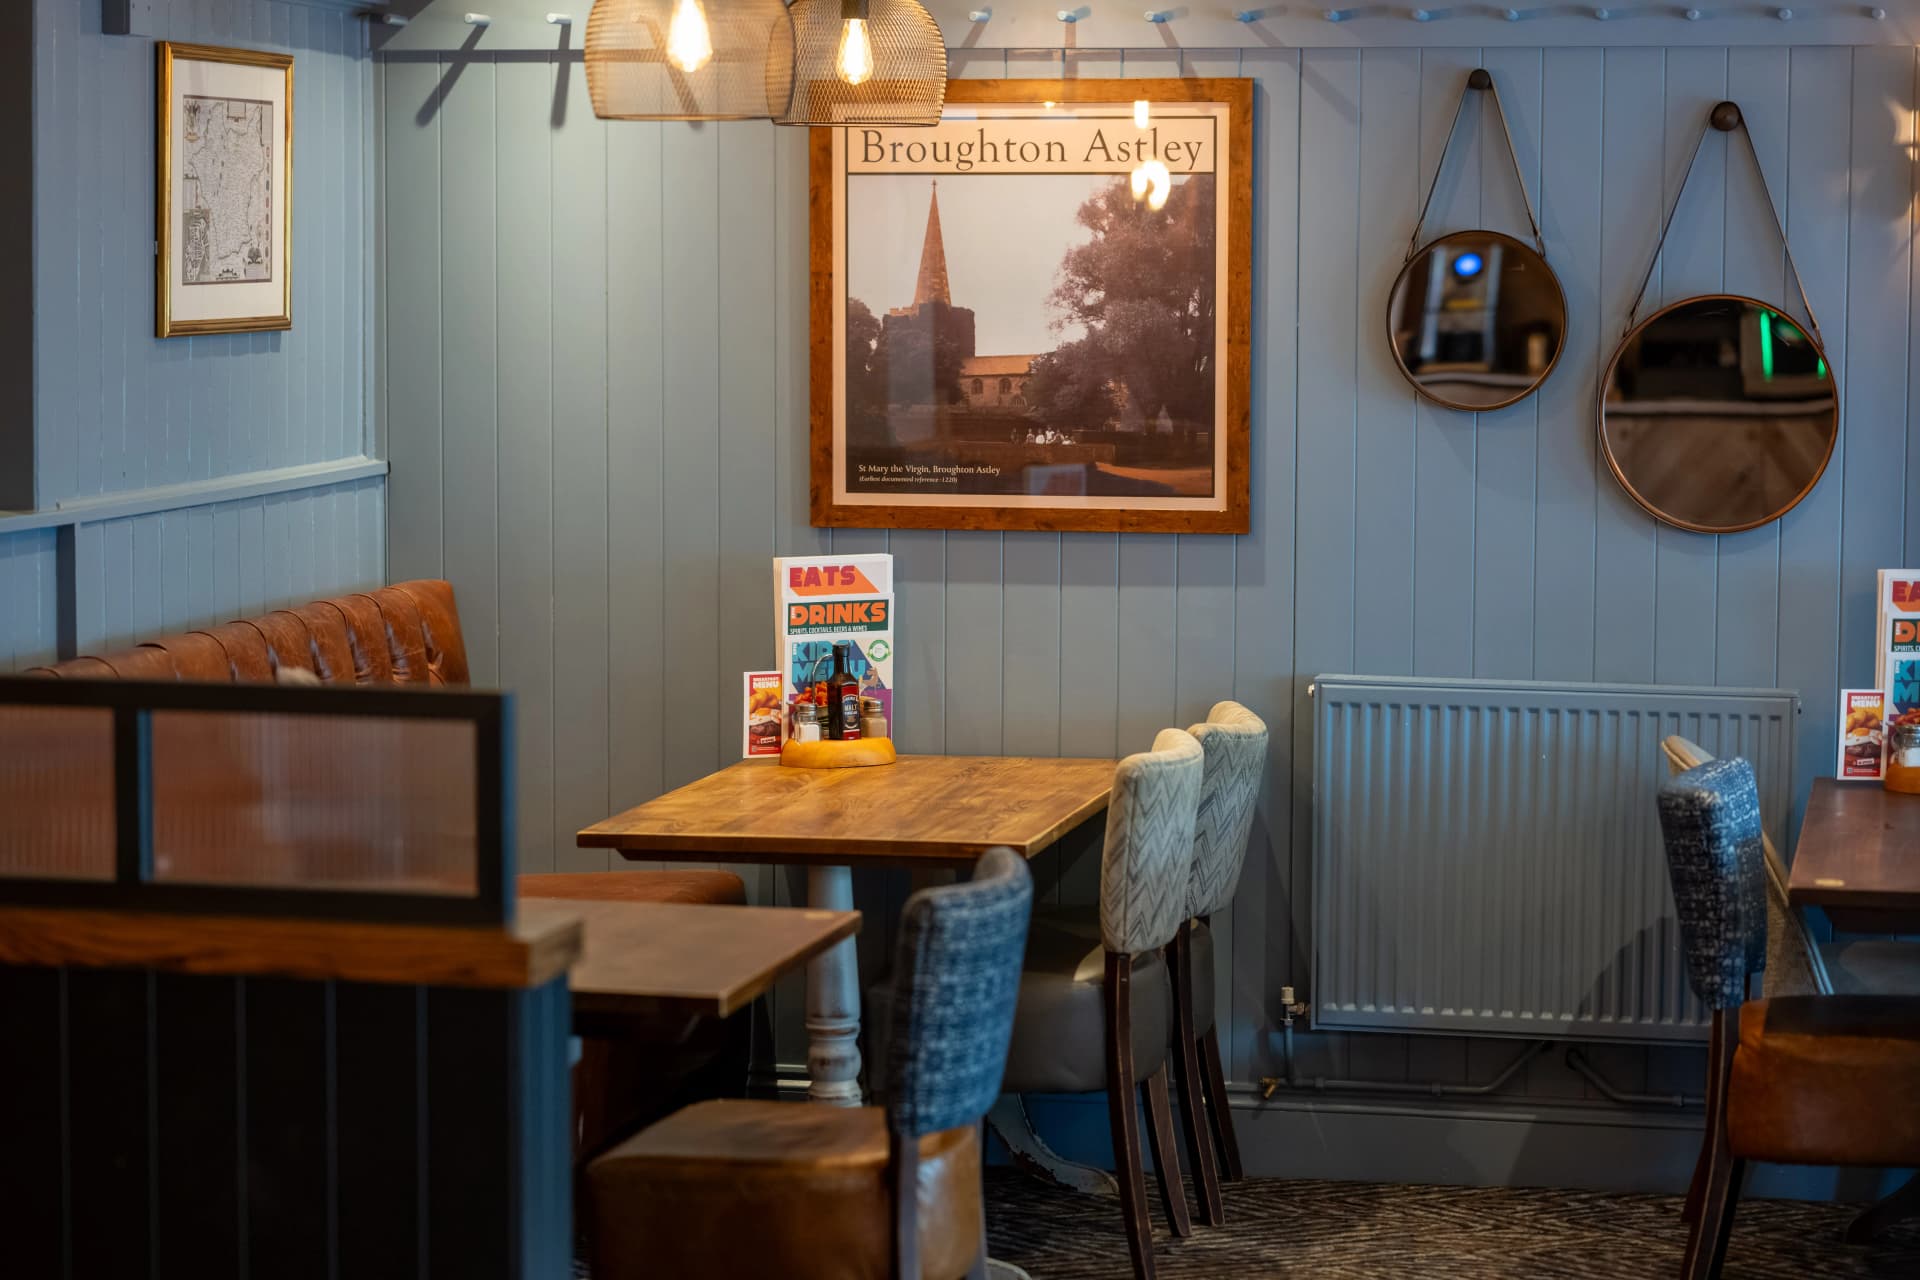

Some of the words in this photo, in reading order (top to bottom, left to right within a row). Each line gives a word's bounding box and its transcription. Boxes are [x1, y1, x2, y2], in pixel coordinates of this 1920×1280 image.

[861, 127, 1067, 171] Broughton
[1083, 128, 1204, 171] Astley
[858, 464, 866, 472] St
[868, 464, 889, 475] Mary
[890, 464, 904, 472] the
[905, 464, 931, 475] Virgin,
[933, 464, 974, 476] Broughton
[976, 465, 1000, 477] Astley
[789, 565, 856, 588] EATS
[790, 602, 886, 626] DRINKS
[809, 626, 834, 635] COCKTAILS,
[834, 625, 848, 633] BEERS
[1894, 621, 1920, 643] D
[752, 681, 780, 689] MENU
[1851, 699, 1880, 708] MENU
